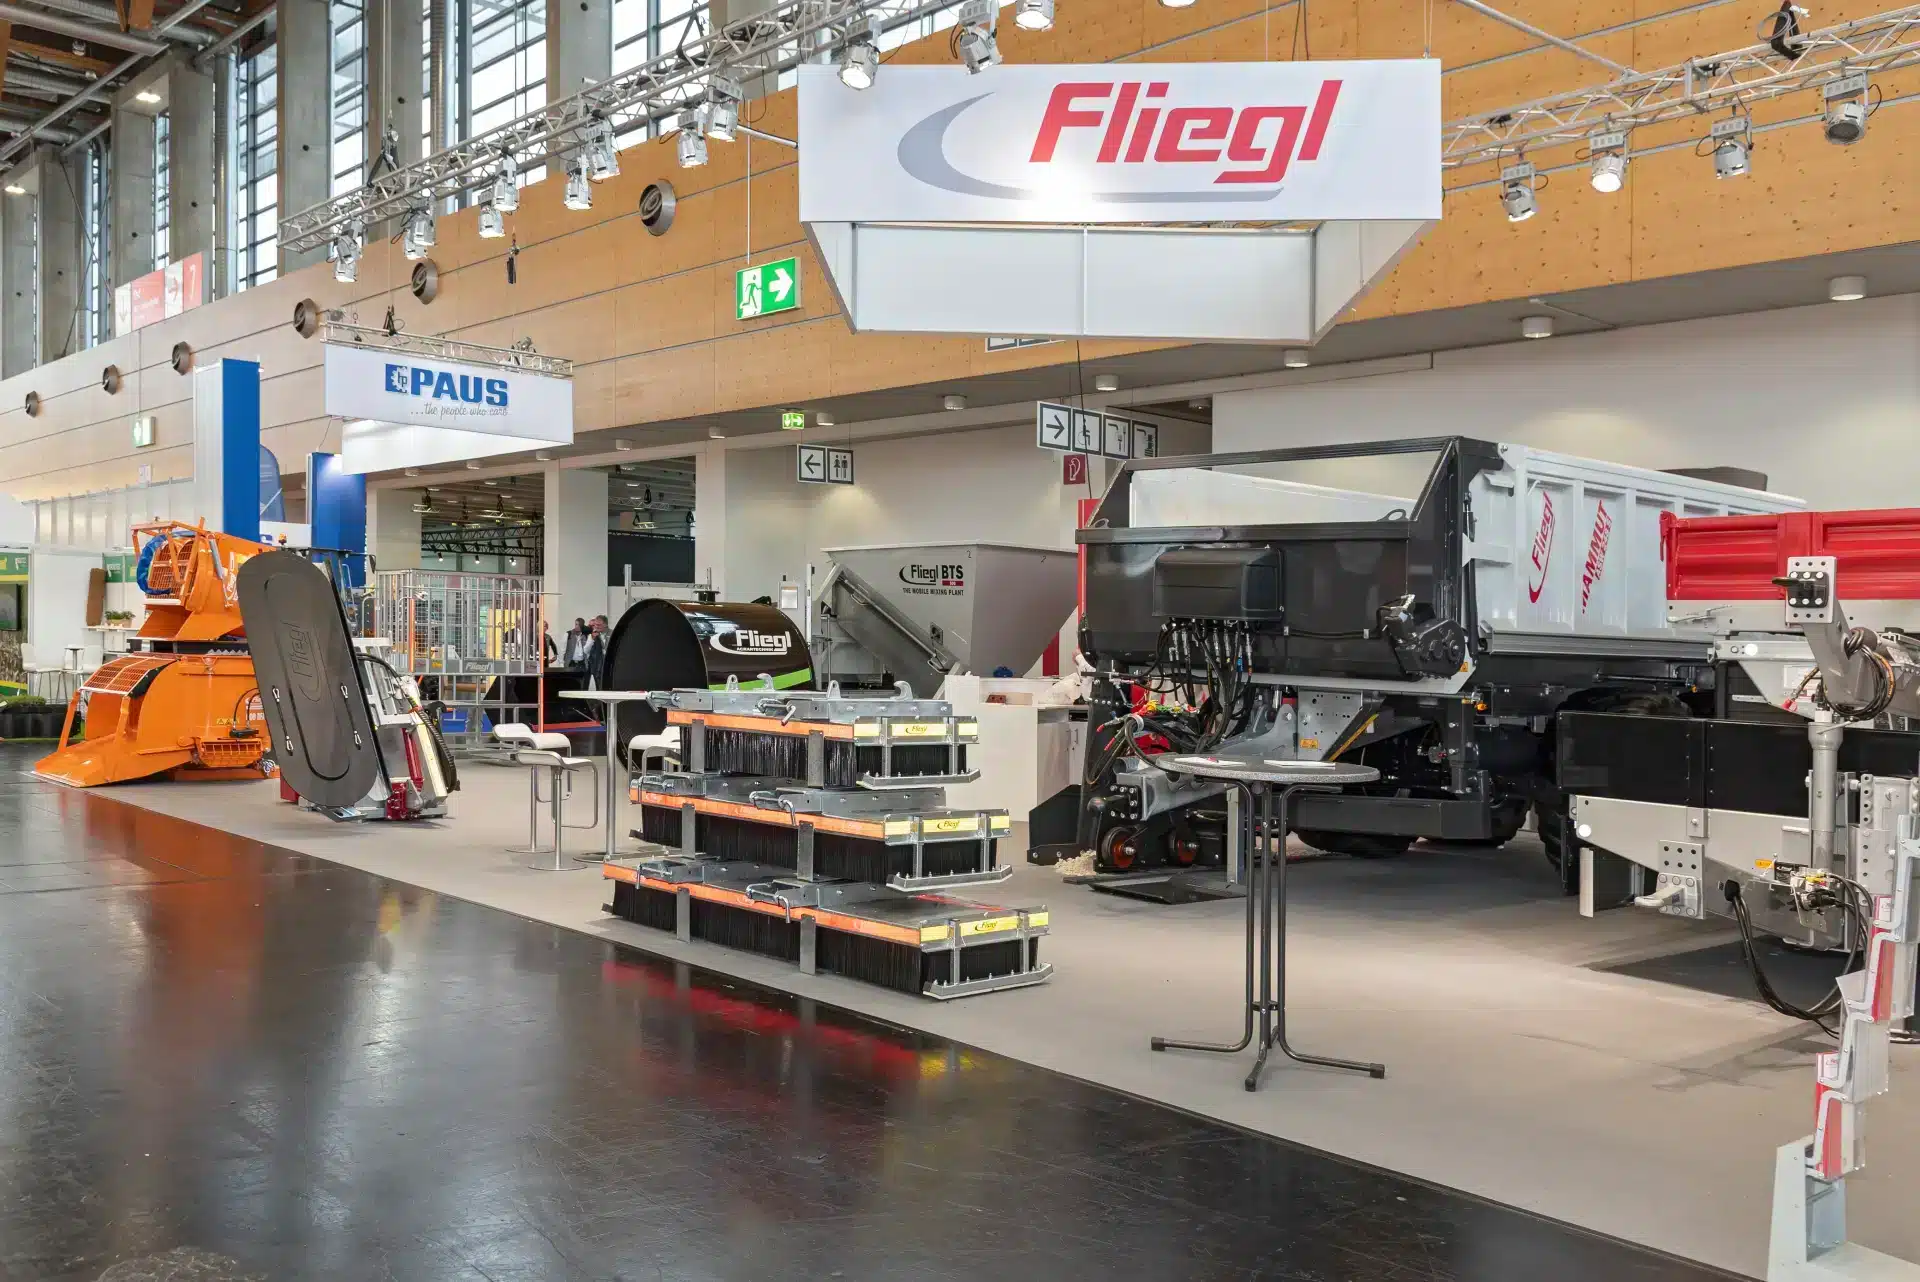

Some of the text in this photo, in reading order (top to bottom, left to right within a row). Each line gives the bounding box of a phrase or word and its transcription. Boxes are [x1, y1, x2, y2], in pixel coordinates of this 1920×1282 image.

[1029, 80, 1344, 183] Fliegl
[411, 367, 508, 406] PAUS
[440, 402, 467, 420] people
[469, 404, 487, 416] who
[489, 408, 508, 416] care
[1532, 489, 1553, 571] Fliegl
[910, 564, 964, 583] Fliegl BTS
[930, 588, 948, 596] MIXING
[280, 619, 313, 678] Fliegl
[735, 629, 792, 652] Fliegl
